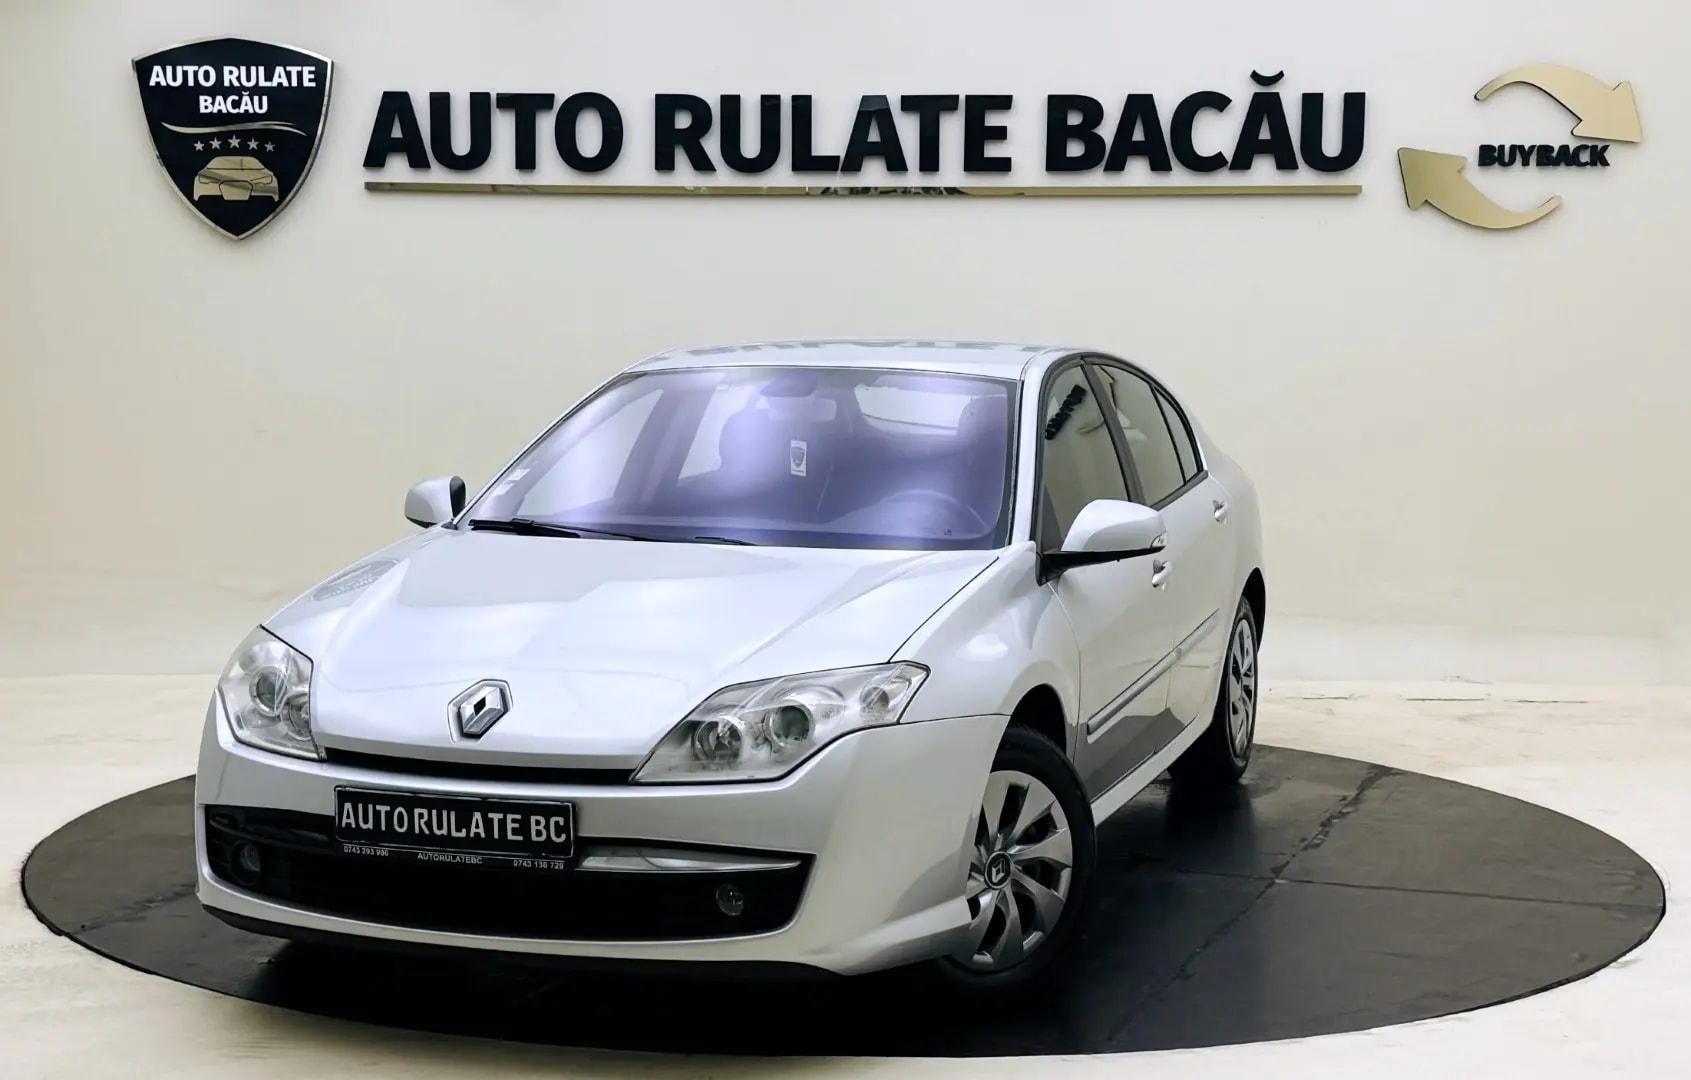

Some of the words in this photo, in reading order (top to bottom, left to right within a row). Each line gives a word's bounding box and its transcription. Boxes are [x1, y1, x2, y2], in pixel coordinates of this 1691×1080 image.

[149, 64, 216, 87] AUTO
[223, 65, 316, 88] RULATE
[198, 91, 268, 114] BACĂU
[363, 90, 624, 172] AUTO
[654, 92, 1013, 173] RULATE
[1046, 69, 1366, 173] BACĂU
[1478, 143, 1610, 167] BUYBACK
[341, 802, 408, 833] AUTO
[414, 807, 523, 841] RULATE
[530, 814, 566, 843] BC
[417, 851, 483, 864] AUTORULATEBC
